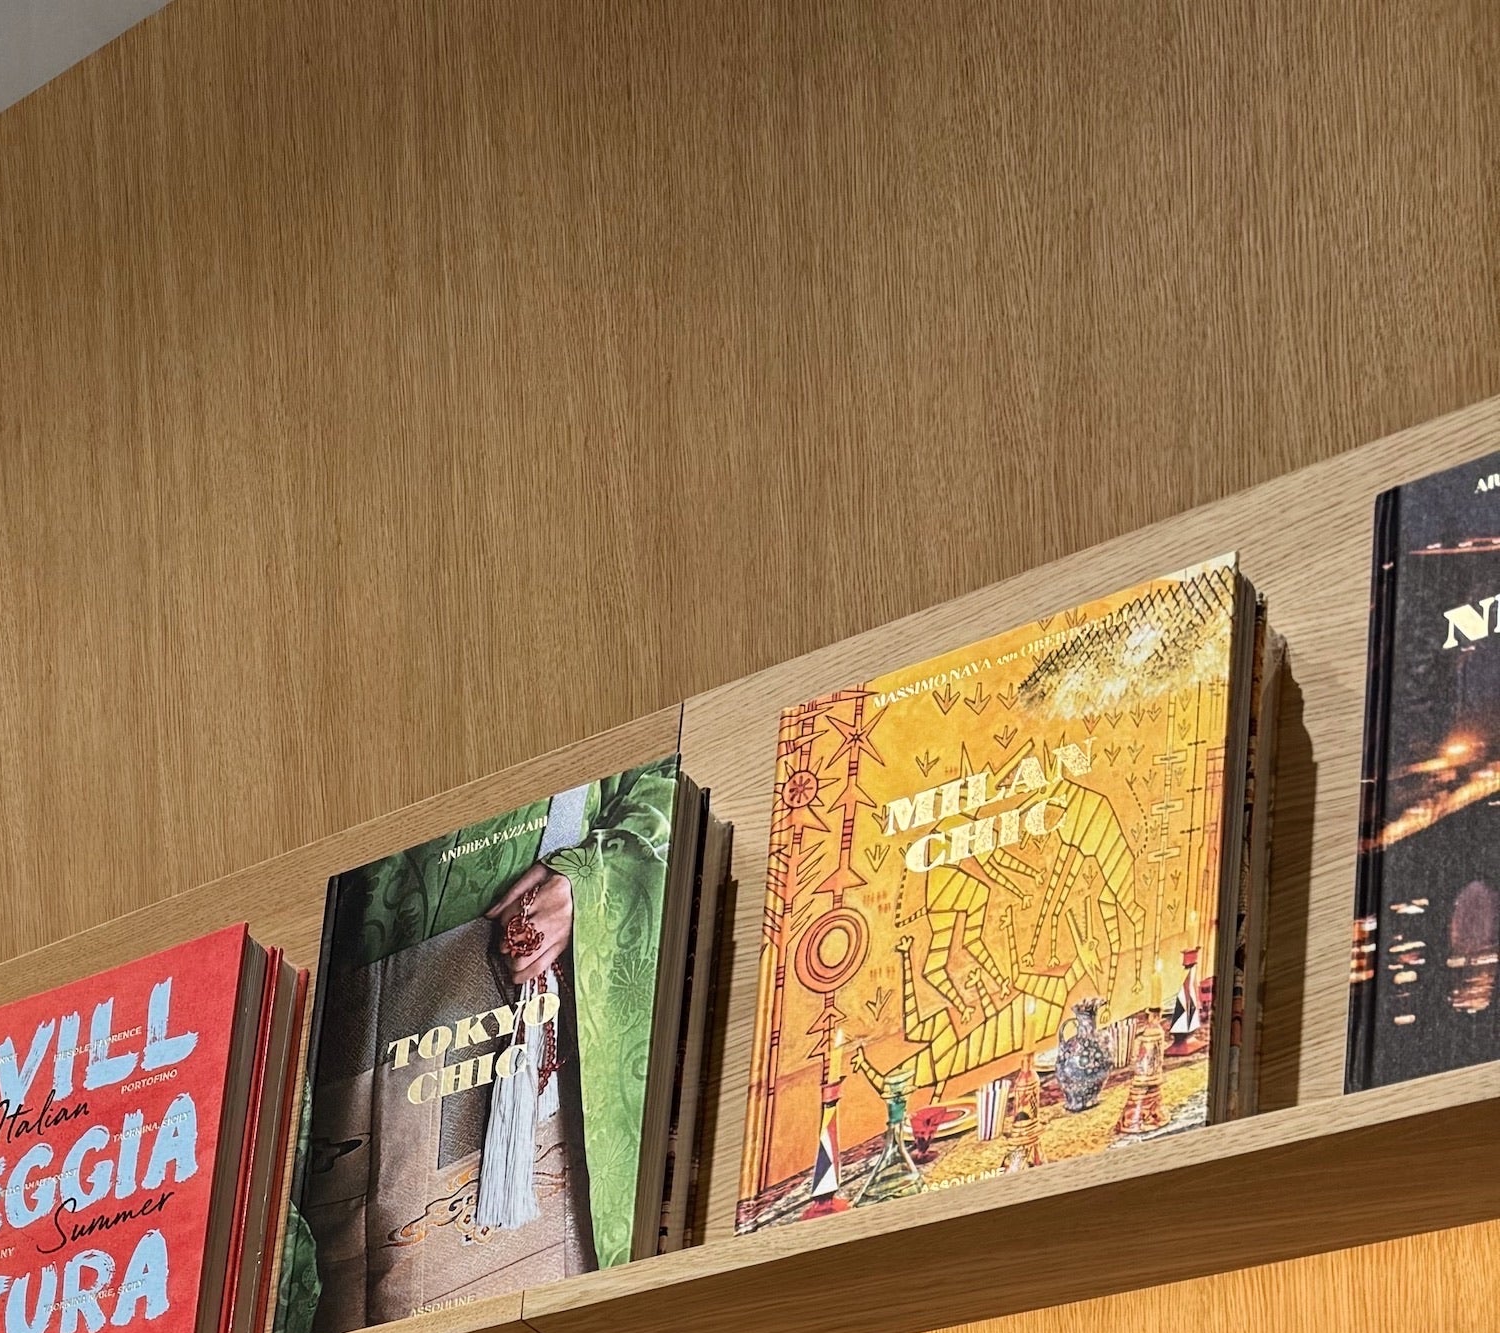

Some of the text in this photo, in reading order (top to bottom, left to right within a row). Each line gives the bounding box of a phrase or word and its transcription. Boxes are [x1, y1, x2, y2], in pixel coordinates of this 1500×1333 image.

[1443, 594, 1500, 649] N
[950, 658, 992, 681] NAVA
[883, 737, 1094, 838] MILAN
[438, 837, 491, 865] ANDREA
[905, 794, 1070, 875] CHIC
[388, 991, 561, 1074] TOKYO
[120, 1068, 178, 1095] PORTOFINO
[407, 1043, 530, 1106] CHIC
[36, 1191, 176, 1255] Summer
